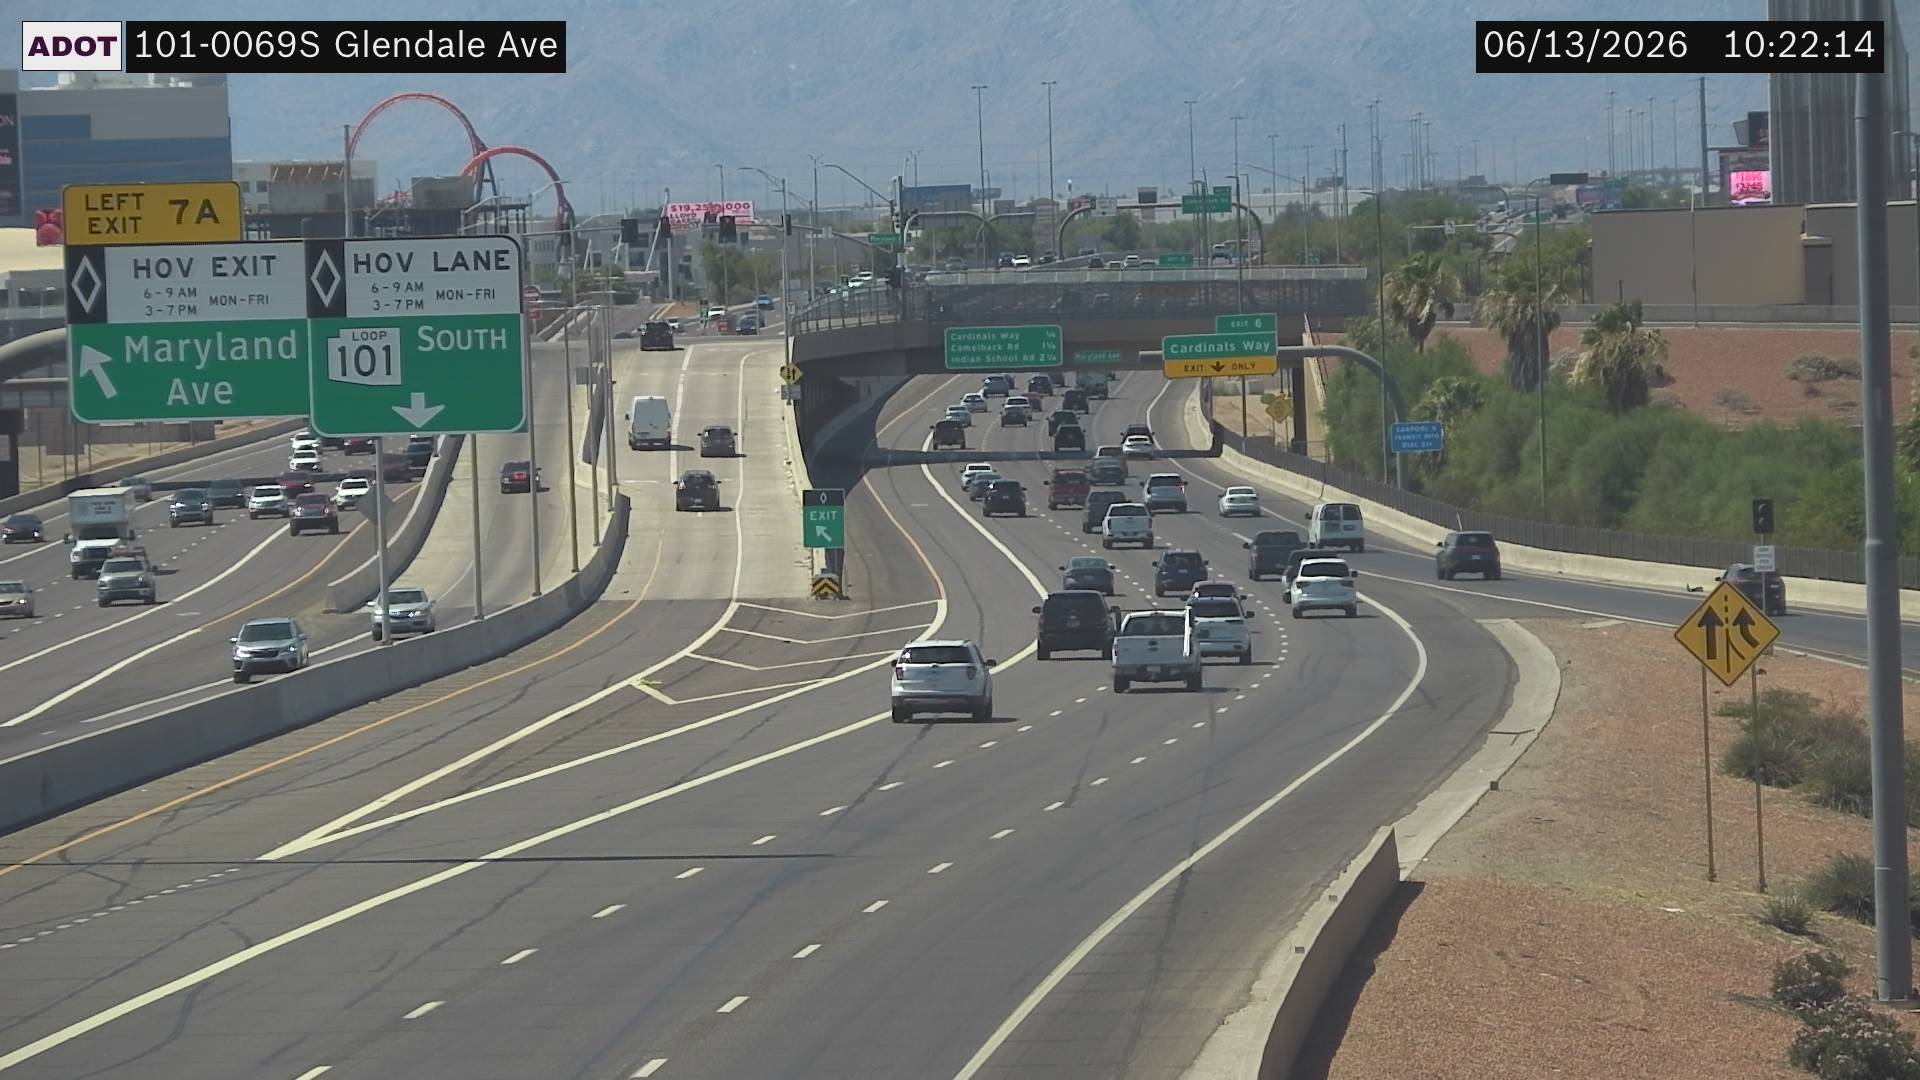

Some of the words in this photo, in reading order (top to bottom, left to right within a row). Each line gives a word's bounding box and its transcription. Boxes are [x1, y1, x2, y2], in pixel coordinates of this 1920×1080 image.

[84, 192, 145, 212] LEFT
[168, 198, 220, 225] 7A
[88, 216, 142, 235] EXIT
[133, 256, 194, 280] HOV
[211, 254, 277, 278] EXIT
[353, 251, 414, 274] HOV
[433, 249, 511, 272] LANE
[1231, 320, 1249, 328] EXIT
[1255, 318, 1262, 328] 6
[351, 330, 388, 341] LOOP
[417, 325, 507, 352] SOUTH
[950, 331, 996, 341] Cardinals
[1000, 331, 1020, 341] Way
[124, 328, 297, 370] Maryland
[951, 343, 1002, 352] Camelback
[1007, 342, 1020, 351] Rd
[1170, 341, 1236, 354] Cardinals
[1242, 340, 1271, 353] Way
[337, 344, 392, 377] 101
[951, 354, 981, 363] Indian
[985, 353, 1018, 362] School
[1184, 364, 1204, 373] EXIT
[1231, 363, 1256, 371] ONLY
[166, 377, 233, 406] Ave
[809, 510, 838, 521] EXIT
